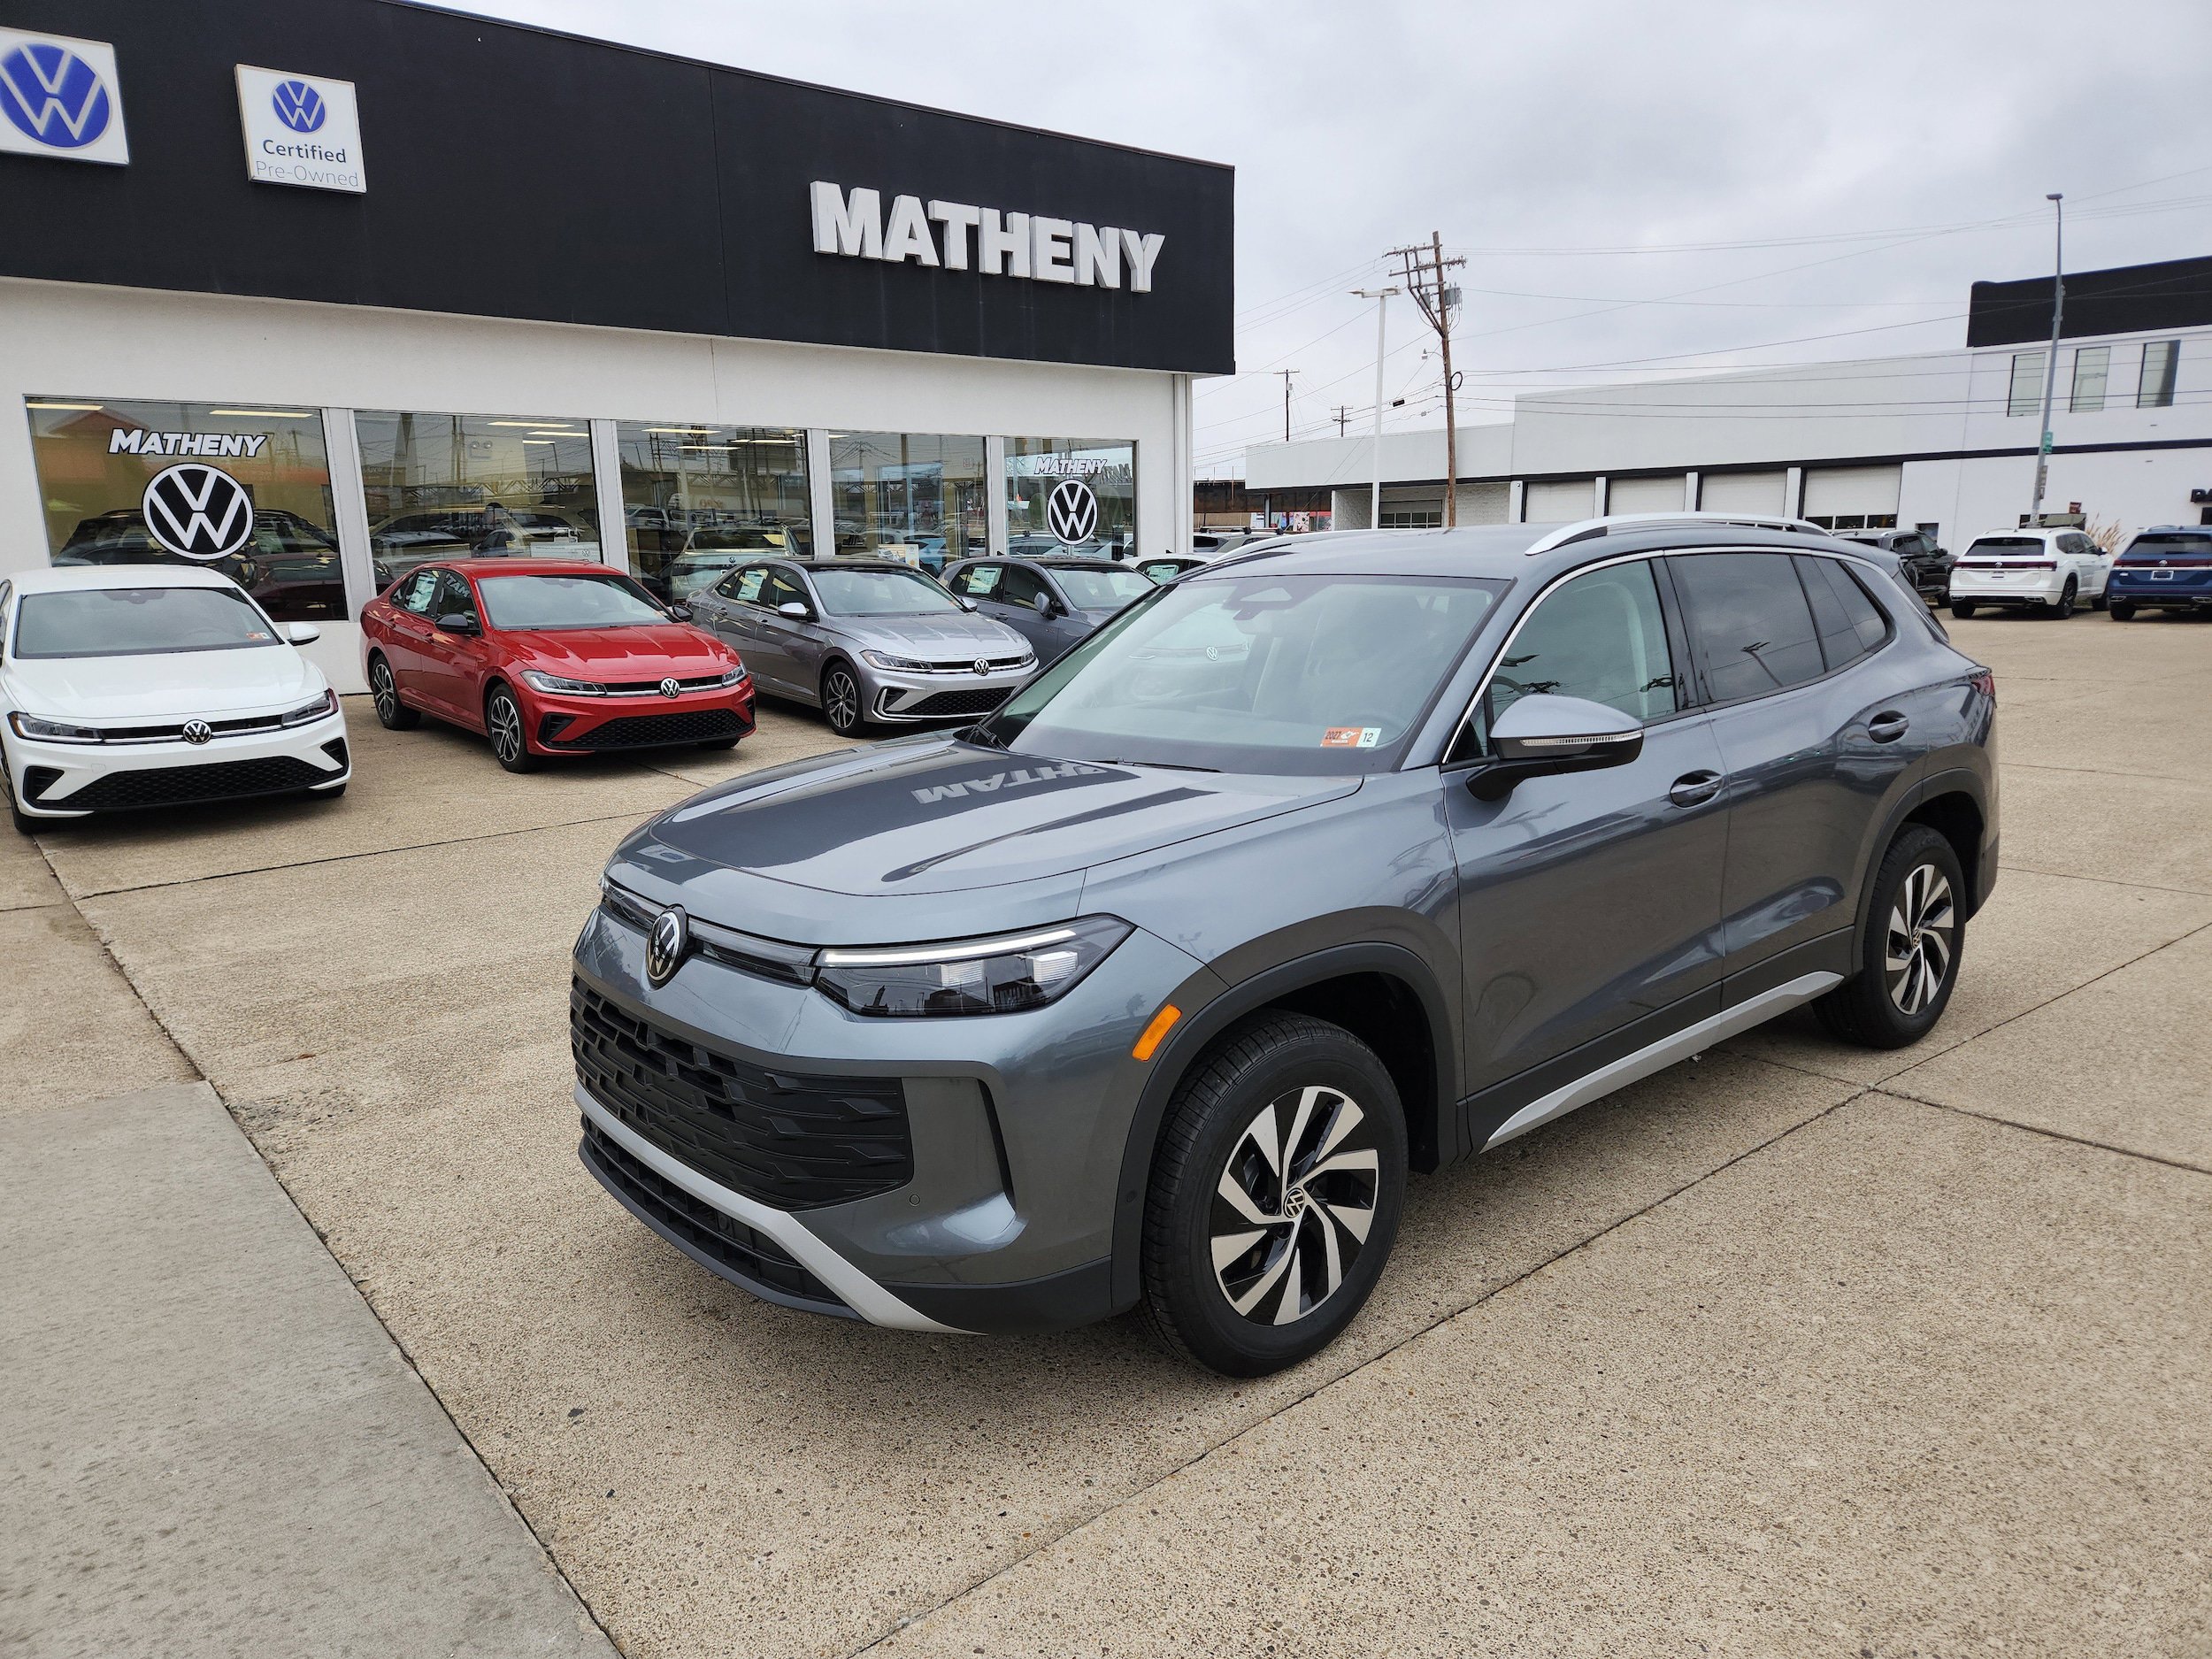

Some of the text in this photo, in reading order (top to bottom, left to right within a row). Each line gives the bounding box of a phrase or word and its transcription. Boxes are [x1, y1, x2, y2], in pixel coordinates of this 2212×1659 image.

[0, 42, 111, 149] VW
[272, 80, 326, 134] VW
[263, 139, 347, 164] Certified
[256, 160, 358, 187] Pre-Owned
[810, 180, 1166, 293] MATHENY
[108, 427, 267, 457] MATHENY
[1034, 457, 1107, 475] MATHENY
[142, 463, 254, 560] VW
[1048, 479, 1098, 545] VW
[661, 677, 680, 698] VW
[183, 719, 211, 745] VW
[1363, 733, 1373, 742] 12
